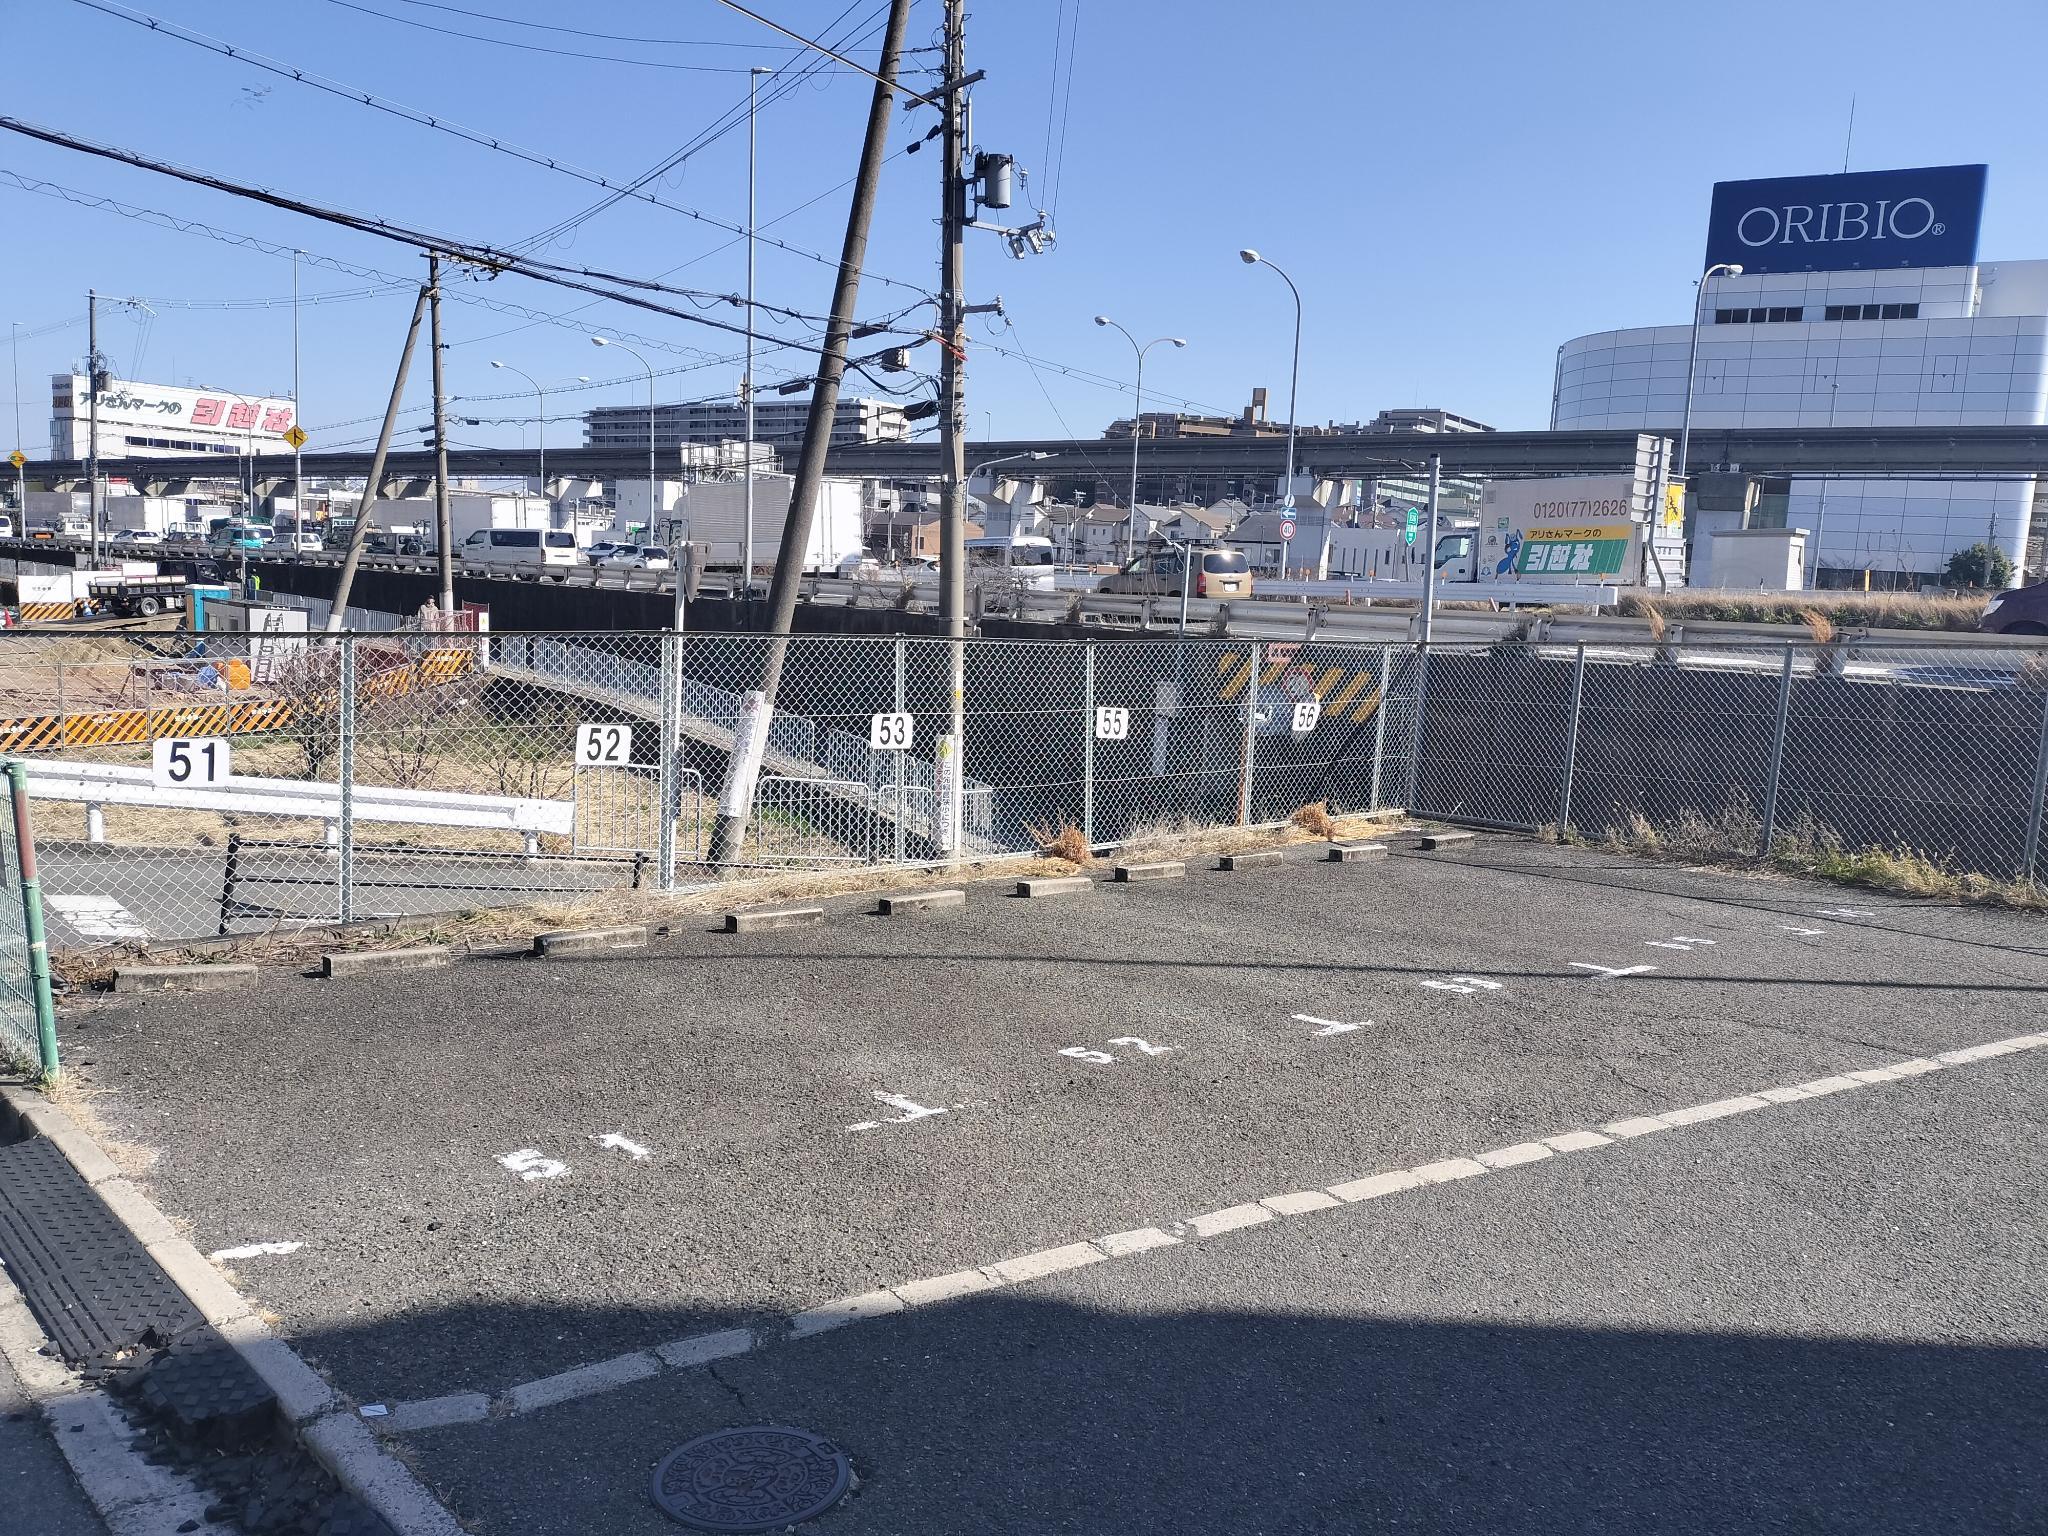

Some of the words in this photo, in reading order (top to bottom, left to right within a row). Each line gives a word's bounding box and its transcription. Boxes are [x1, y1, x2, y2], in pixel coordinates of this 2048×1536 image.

[190, 398, 293, 432] 引越社
[1533, 500, 1627, 519] 0120(77)2626
[1529, 528, 1602, 539] アリさんマークの
[1525, 543, 1594, 571] 引越社
[879, 716, 905, 745] 53
[1103, 709, 1122, 736] 55
[1299, 705, 1317, 729] 56
[586, 727, 620, 761] 52
[168, 741, 216, 782] 51
